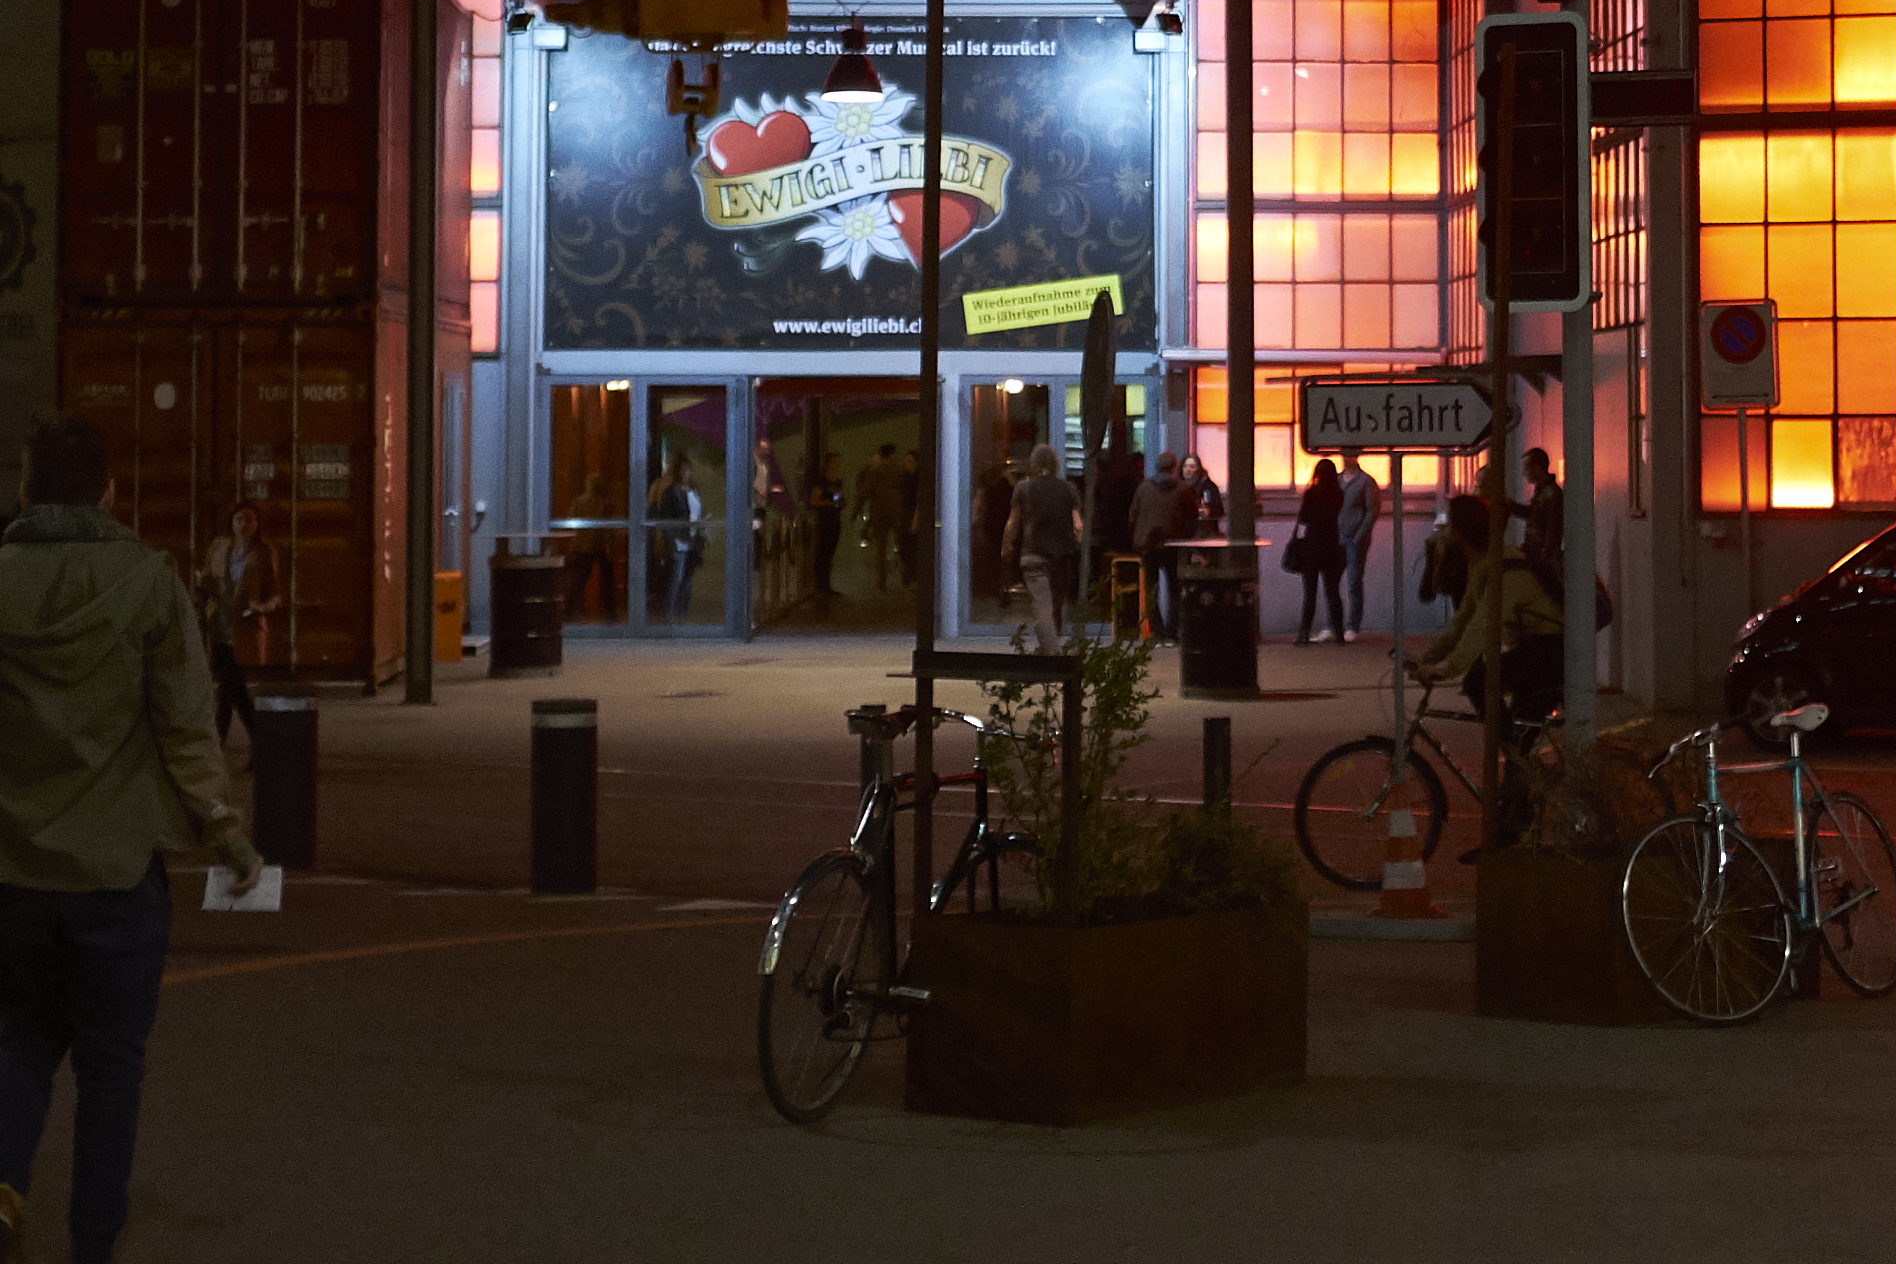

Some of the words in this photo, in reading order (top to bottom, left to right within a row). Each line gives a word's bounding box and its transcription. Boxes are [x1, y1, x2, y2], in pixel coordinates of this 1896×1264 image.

[805, 39, 893, 55] Schwzer
[896, 39, 962, 55] Musal
[966, 39, 987, 55] ist
[992, 38, 1057, 56] zurück!
[714, 155, 853, 219] EWIGI
[867, 143, 993, 191] LIBI
[971, 288, 1082, 312] Wiederaufnahme
[978, 306, 1050, 326] 10-jährigen
[1053, 300, 1093, 316] Jubilä
